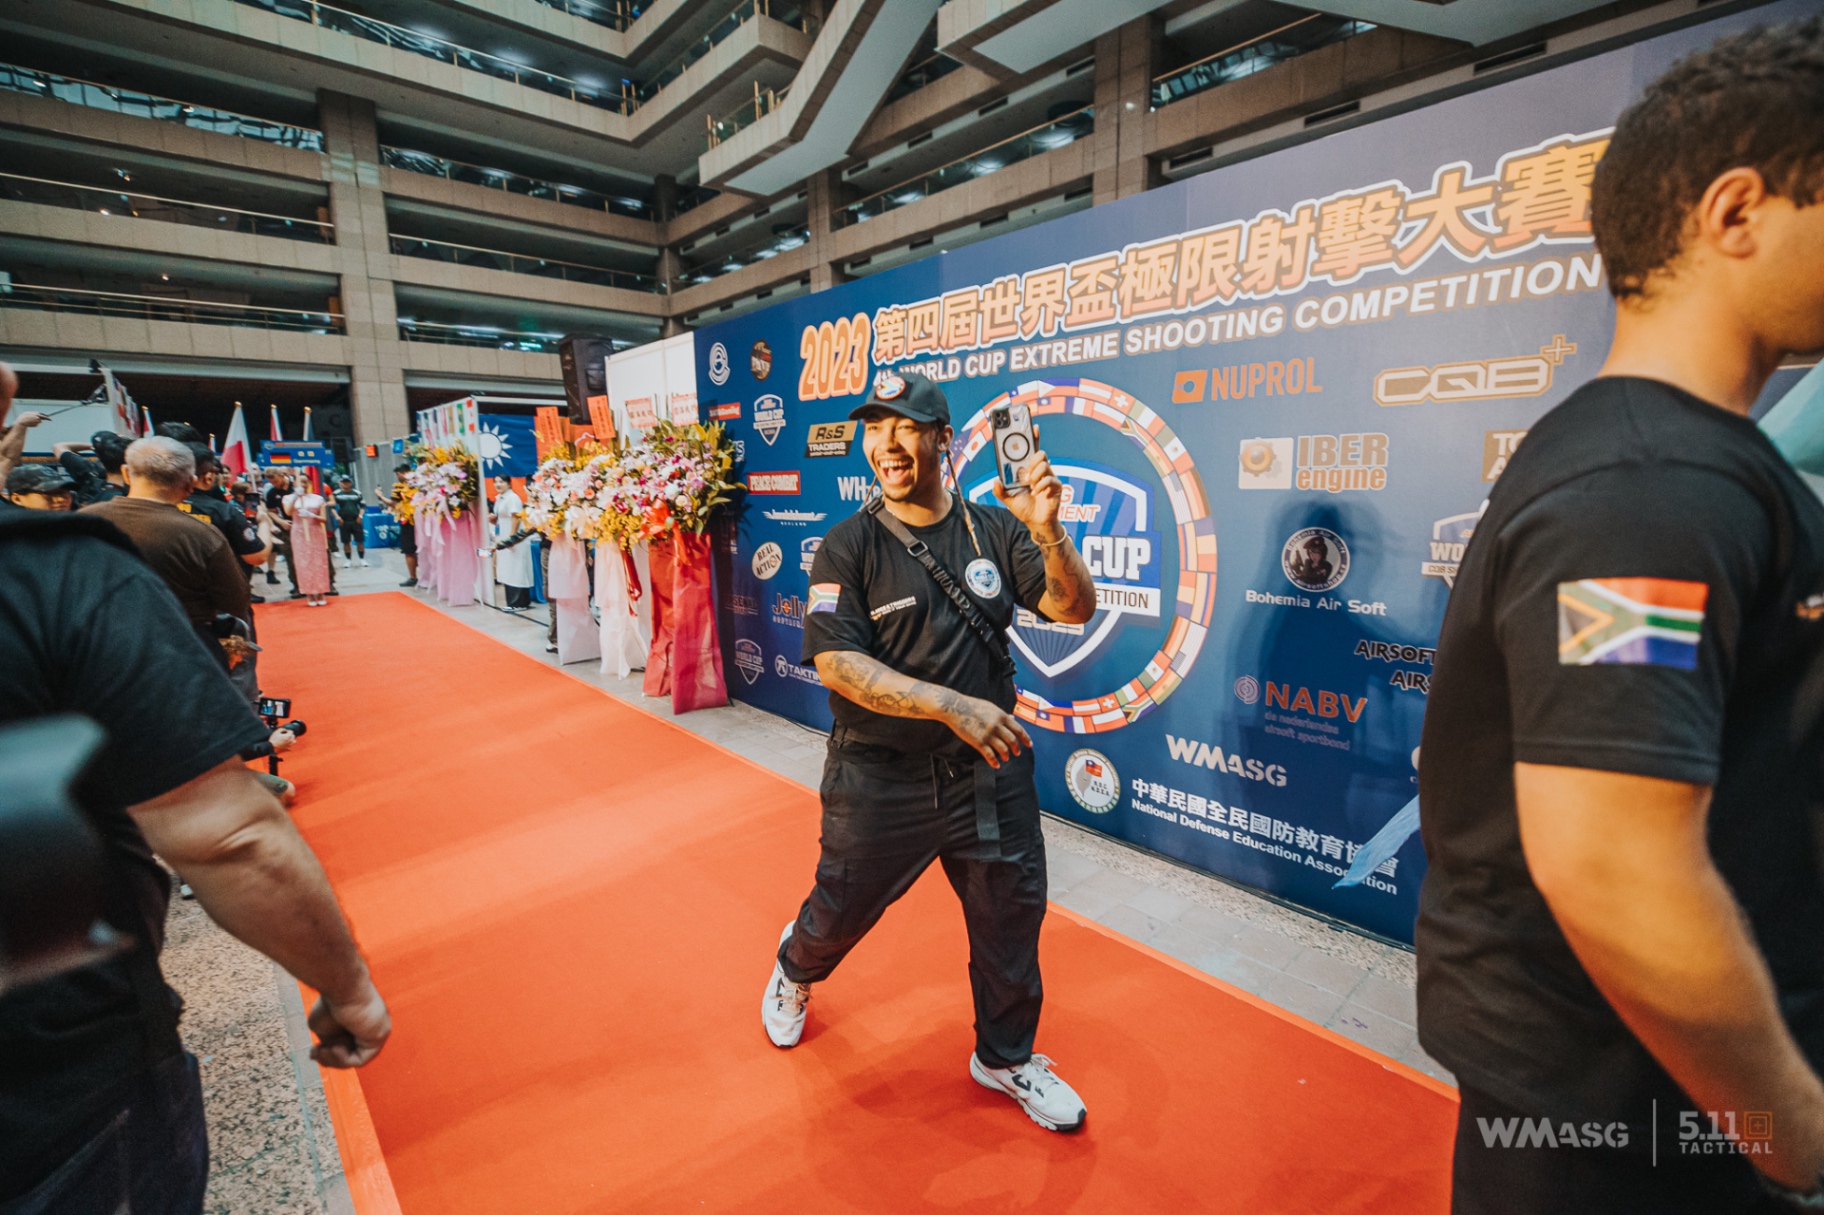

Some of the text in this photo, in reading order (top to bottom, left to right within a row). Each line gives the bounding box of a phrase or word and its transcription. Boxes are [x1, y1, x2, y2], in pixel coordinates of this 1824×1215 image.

[965, 351, 1006, 377] CUP
[1010, 332, 1119, 370] EXTREME
[1125, 305, 1284, 352] SHOOTING
[1294, 253, 1603, 329] COMPETITION
[799, 312, 871, 401] 2023
[1211, 357, 1322, 401] NUPROL
[808, 442, 846, 452] TRADERS
[1296, 432, 1389, 468] IBER
[1296, 466, 1387, 493] engine
[756, 553, 782, 576] ACTION
[757, 544, 774, 561] REAL
[1082, 535, 1151, 580] CUP
[1245, 589, 1387, 616] Bohemia Air Soft
[1265, 681, 1368, 723] NABV
[1165, 734, 1287, 787] WMASG
[1132, 799, 1177, 823] National
[1180, 813, 1230, 840] Defense
[1233, 831, 1302, 863] Education
